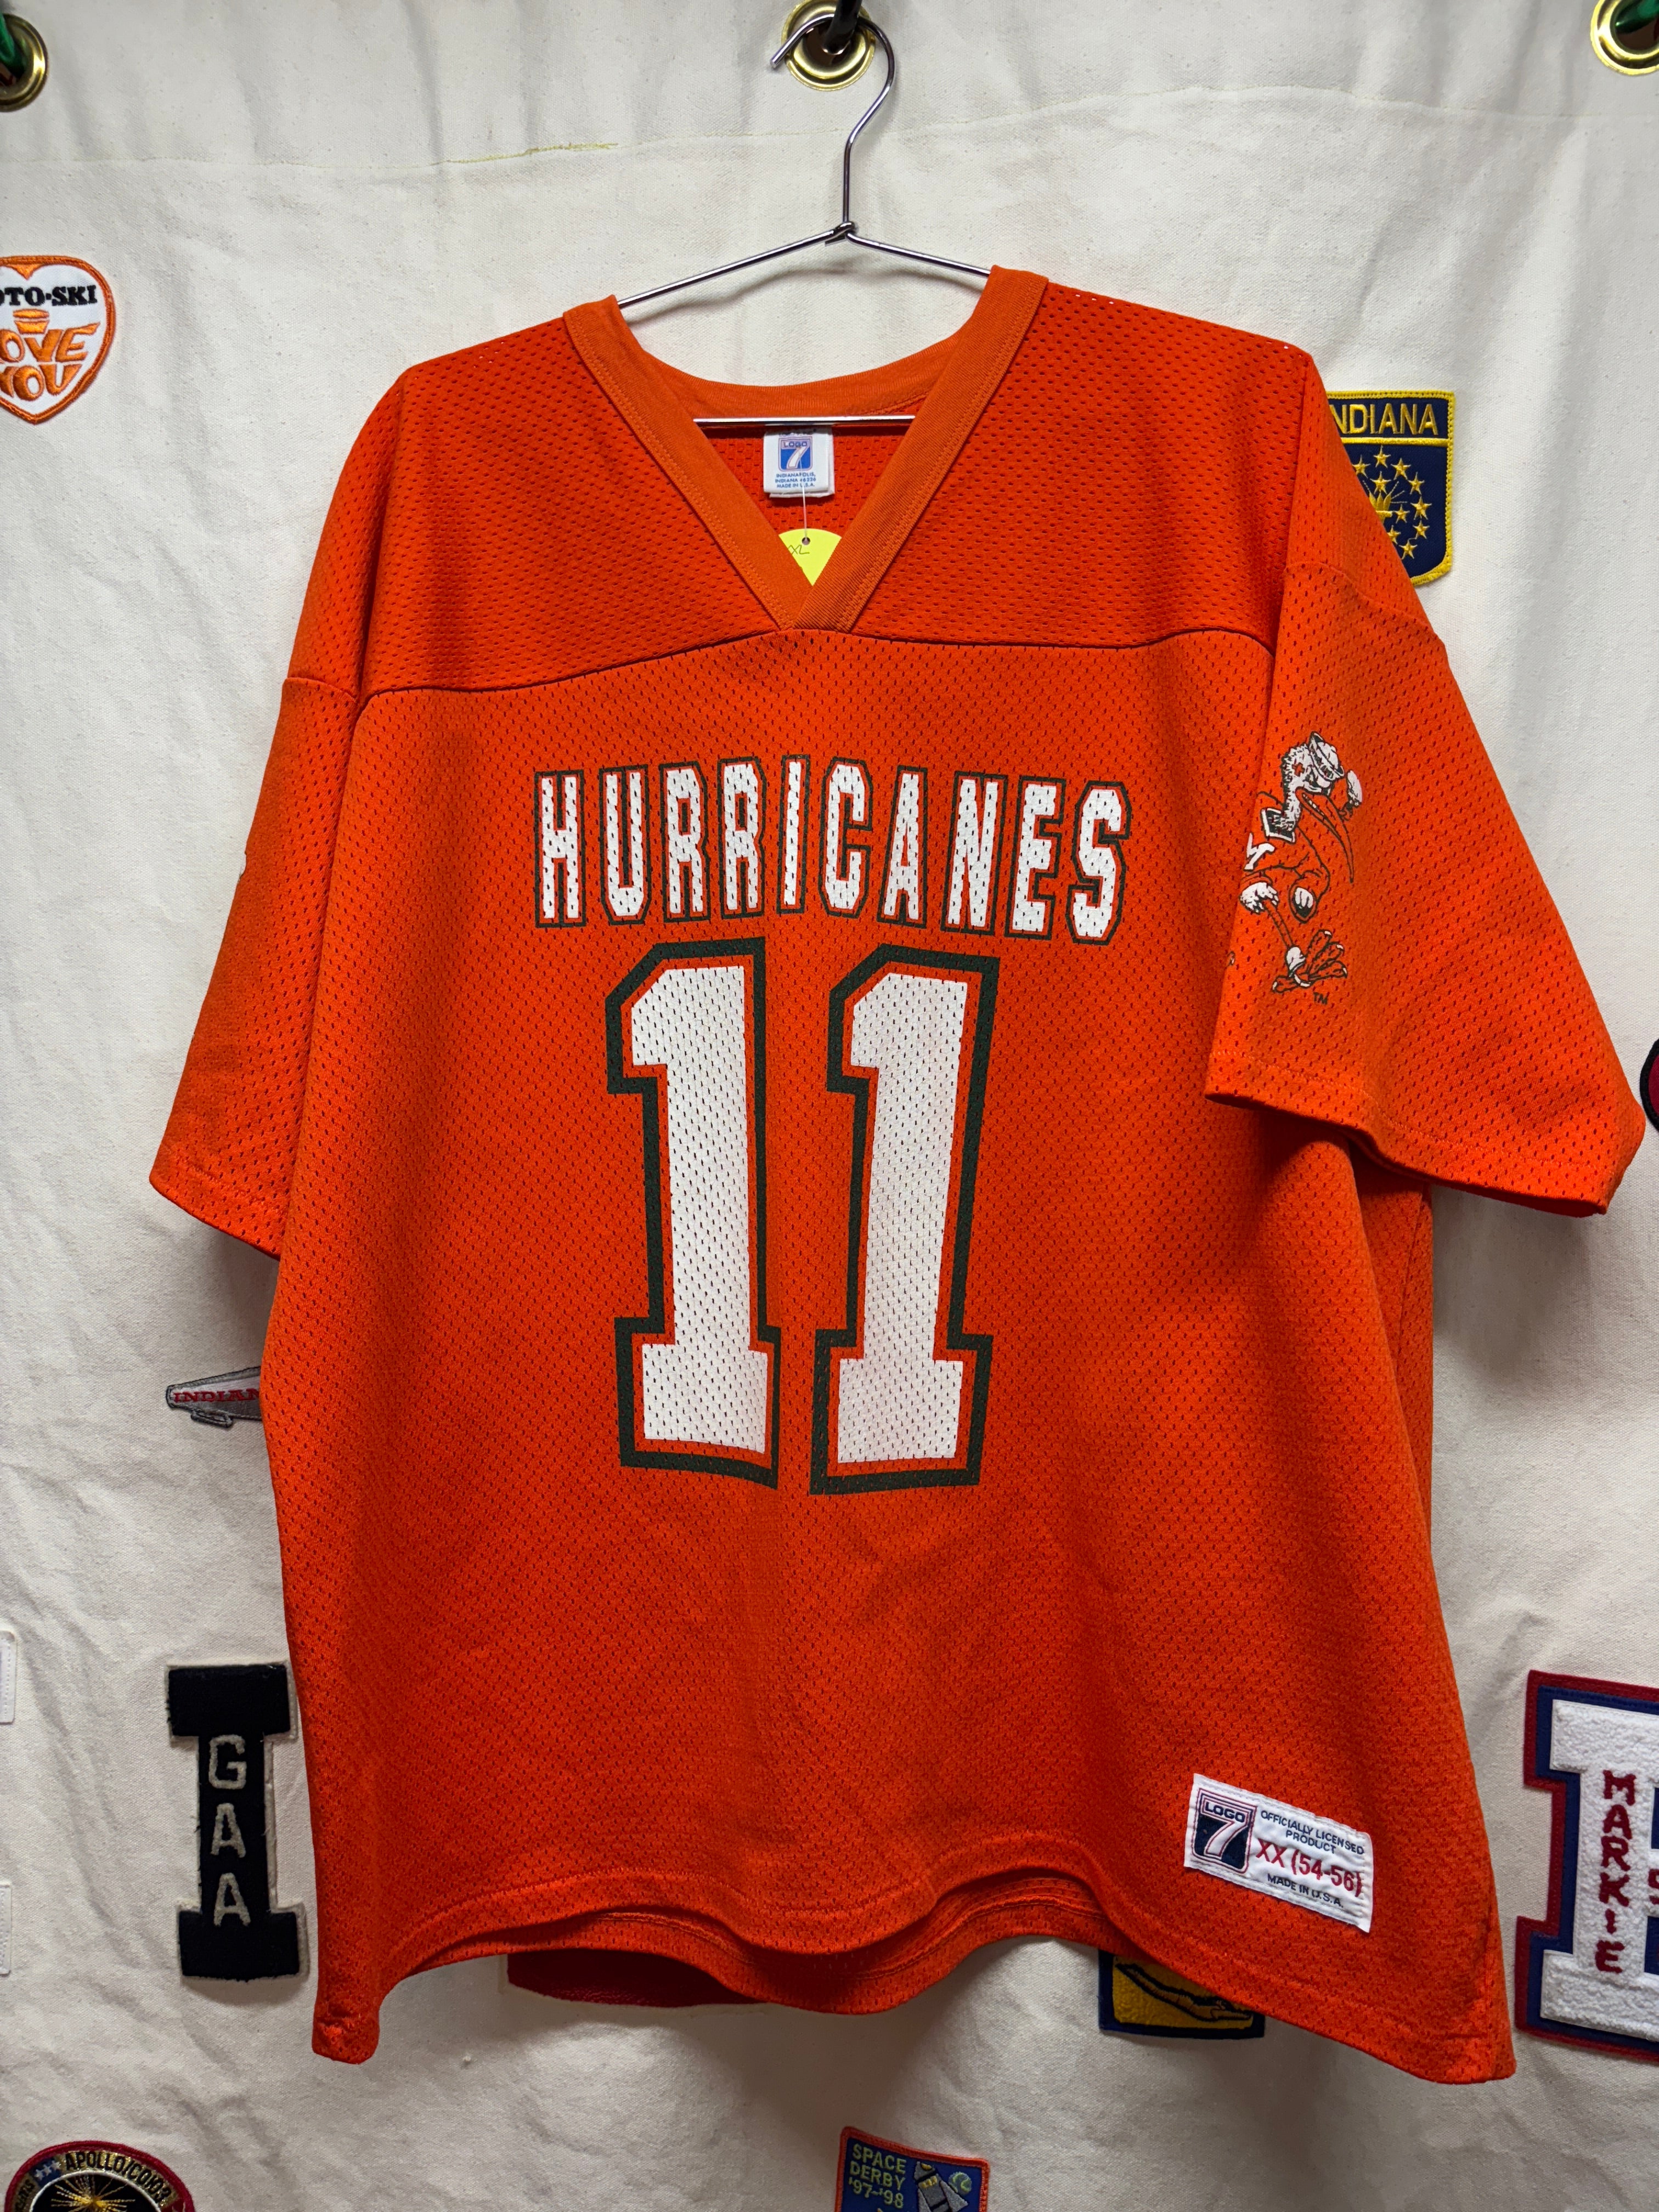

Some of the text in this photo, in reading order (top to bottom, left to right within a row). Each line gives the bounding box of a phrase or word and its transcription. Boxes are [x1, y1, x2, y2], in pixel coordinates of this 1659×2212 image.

[0, 322, 100, 363] OVE
[1329, 403, 1438, 435] NDIANA
[534, 754, 1131, 946] HURRICANES
[1313, 992, 1328, 1005] TM
[605, 936, 1000, 1496] 11
[1200, 1797, 1250, 1859] 7
[1205, 1801, 1246, 1823] LOGO
[1261, 1810, 1364, 1855] OFFICIALLY LICENSED
[1286, 1830, 1336, 1854] PRODUCT
[1256, 1838, 1362, 1898] XX (54-56)
[1594, 1769, 1637, 1974] MARKIE
[1267, 1874, 1344, 1908] MADE IN U.S.A.
[849, 2160, 906, 2191] DERBY
[852, 2143, 907, 2174] SPACE
